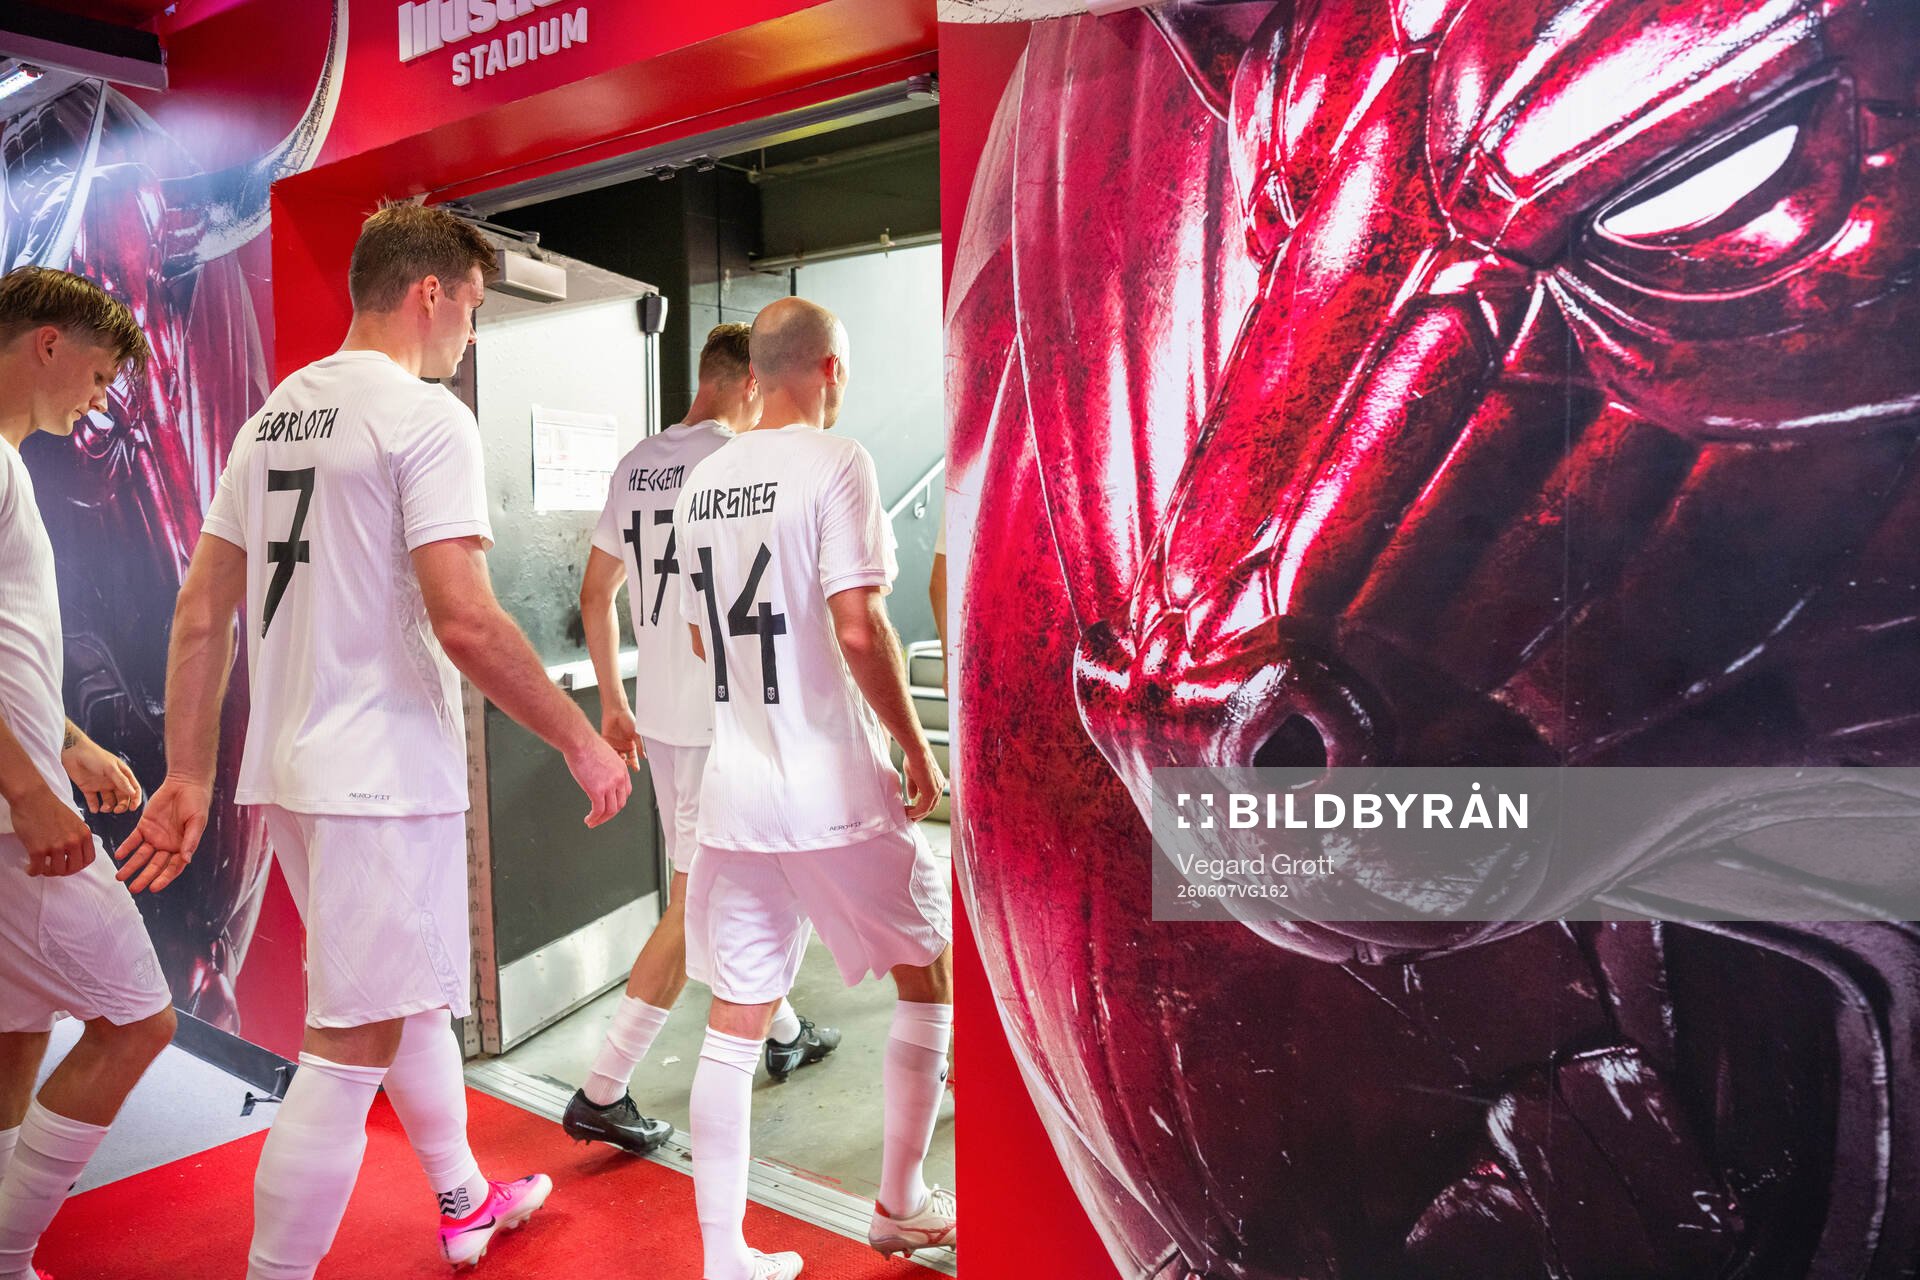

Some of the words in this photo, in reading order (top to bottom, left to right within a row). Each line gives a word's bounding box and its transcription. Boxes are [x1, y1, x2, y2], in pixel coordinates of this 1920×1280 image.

[451, 6, 588, 87] STADIUM
[255, 407, 339, 442] SØRLOTH
[628, 464, 685, 491] HEGGEM
[688, 481, 778, 523] AURSNES
[261, 466, 316, 640] 7
[623, 509, 680, 627] 17
[690, 542, 787, 704] 14
